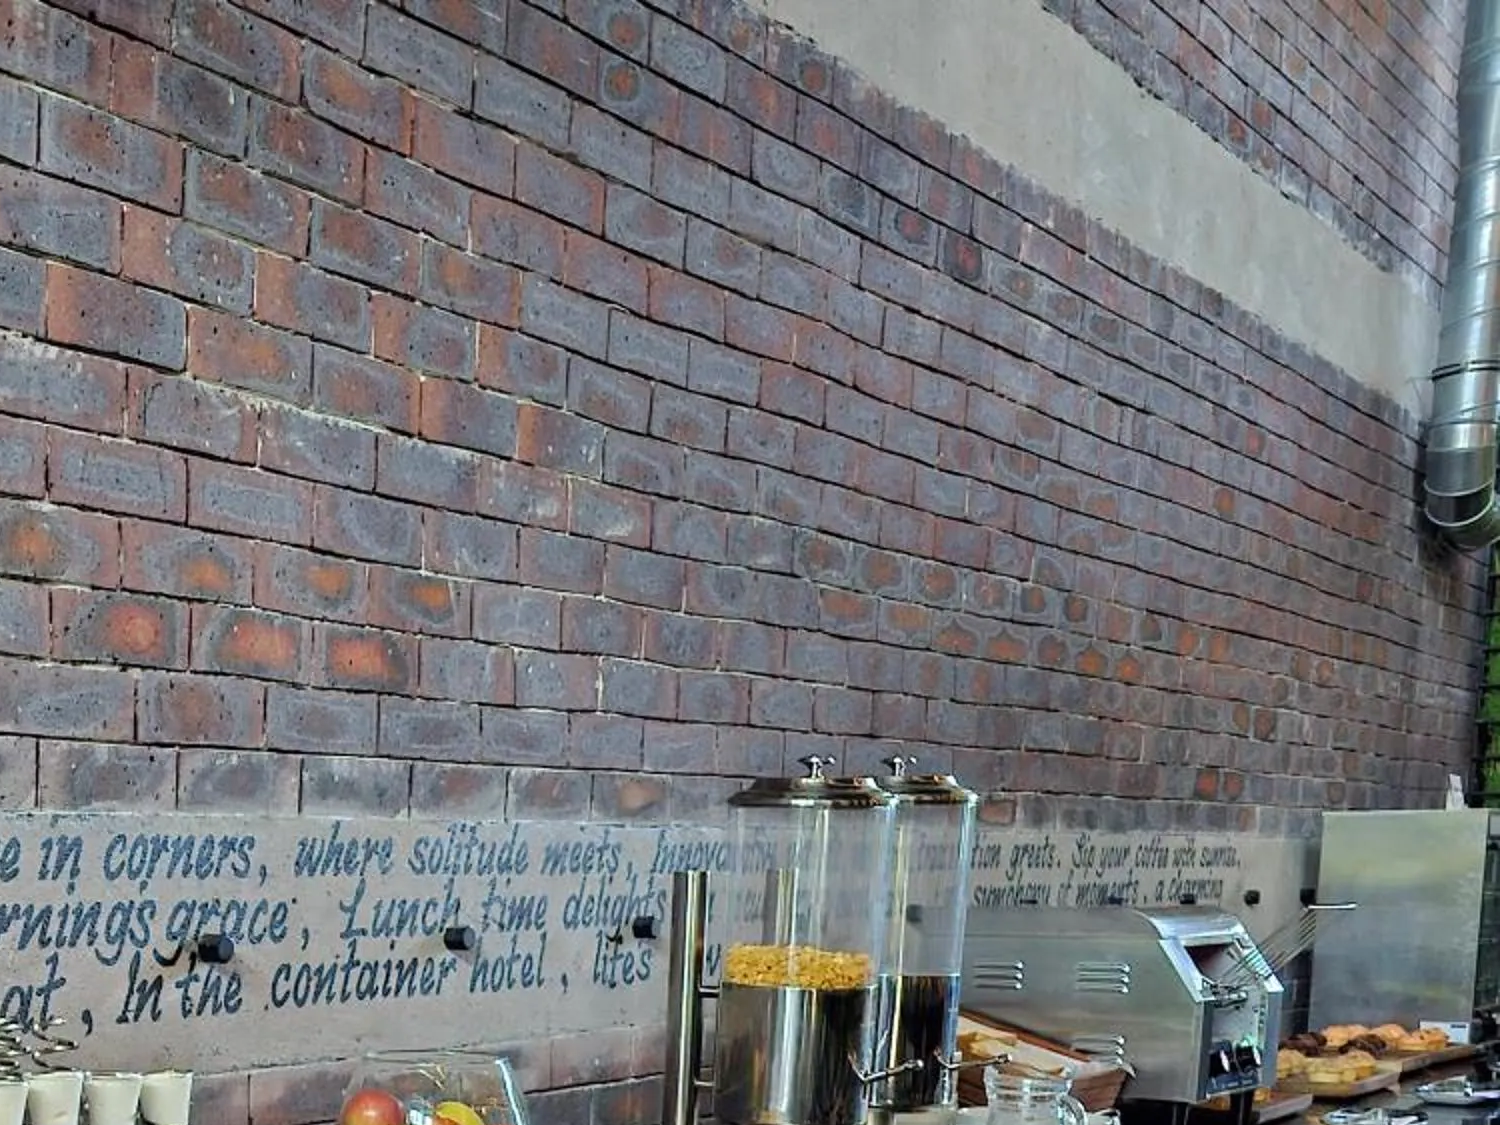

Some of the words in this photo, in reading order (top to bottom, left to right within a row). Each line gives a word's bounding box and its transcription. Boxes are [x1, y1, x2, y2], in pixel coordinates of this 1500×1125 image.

[38, 830, 83, 882] in
[103, 832, 268, 881] corners,
[294, 820, 394, 878] where
[408, 822, 529, 877] solitude
[340, 878, 461, 939] Lunch
[481, 877, 549, 933] time
[562, 872, 666, 941] delights
[116, 950, 162, 1023] In
[175, 951, 243, 1018] the
[270, 938, 457, 1008] container
